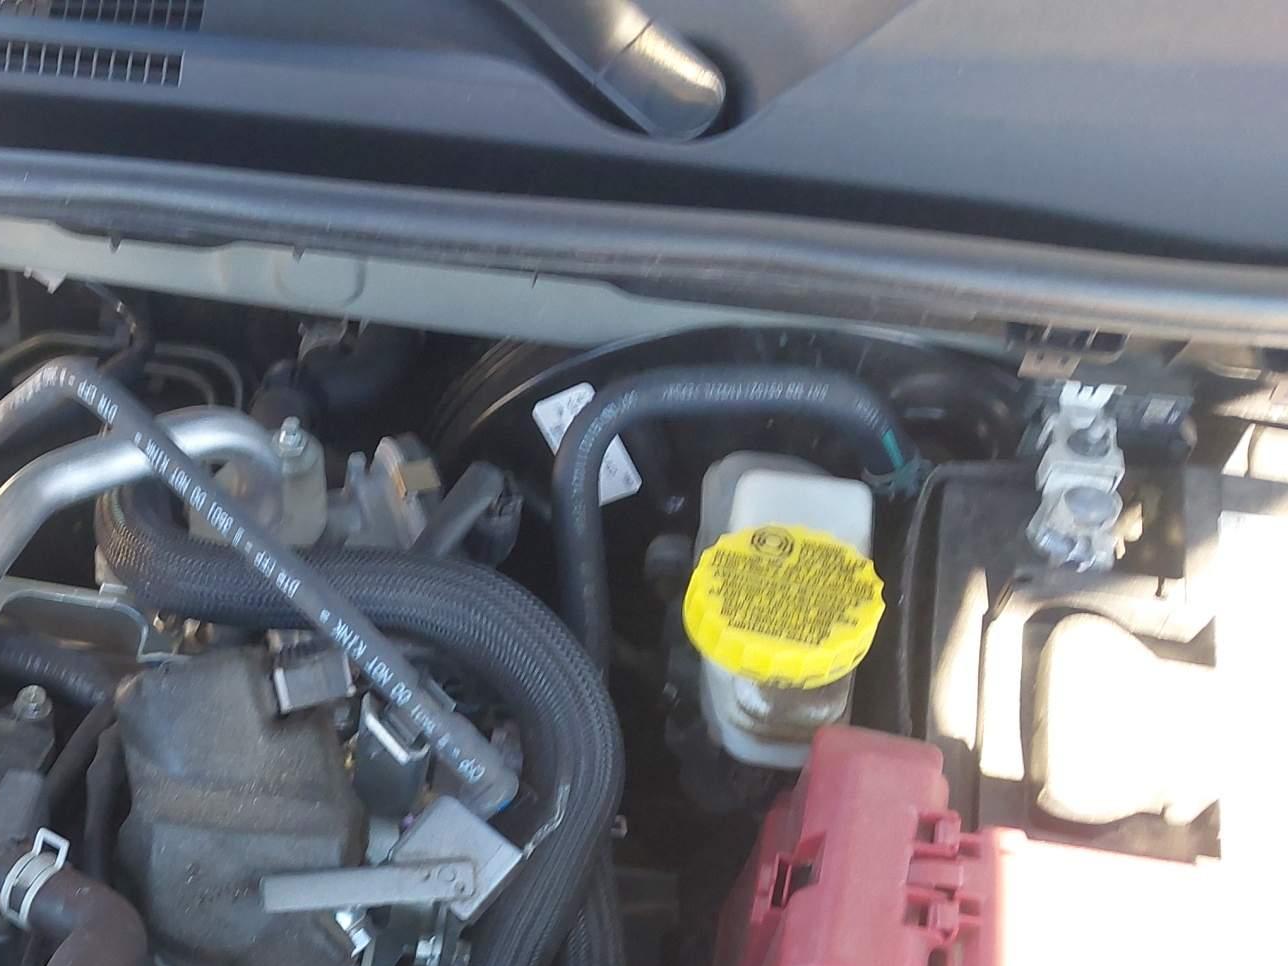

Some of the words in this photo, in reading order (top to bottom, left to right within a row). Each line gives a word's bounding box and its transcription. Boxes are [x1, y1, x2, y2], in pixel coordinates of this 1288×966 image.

[146, 439, 170, 473] KINK
[168, 467, 191, 496] NOT
[190, 485, 208, 512] DO
[333, 619, 367, 660] KINK
[365, 656, 394, 687] NOT
[391, 682, 412, 705] DO
